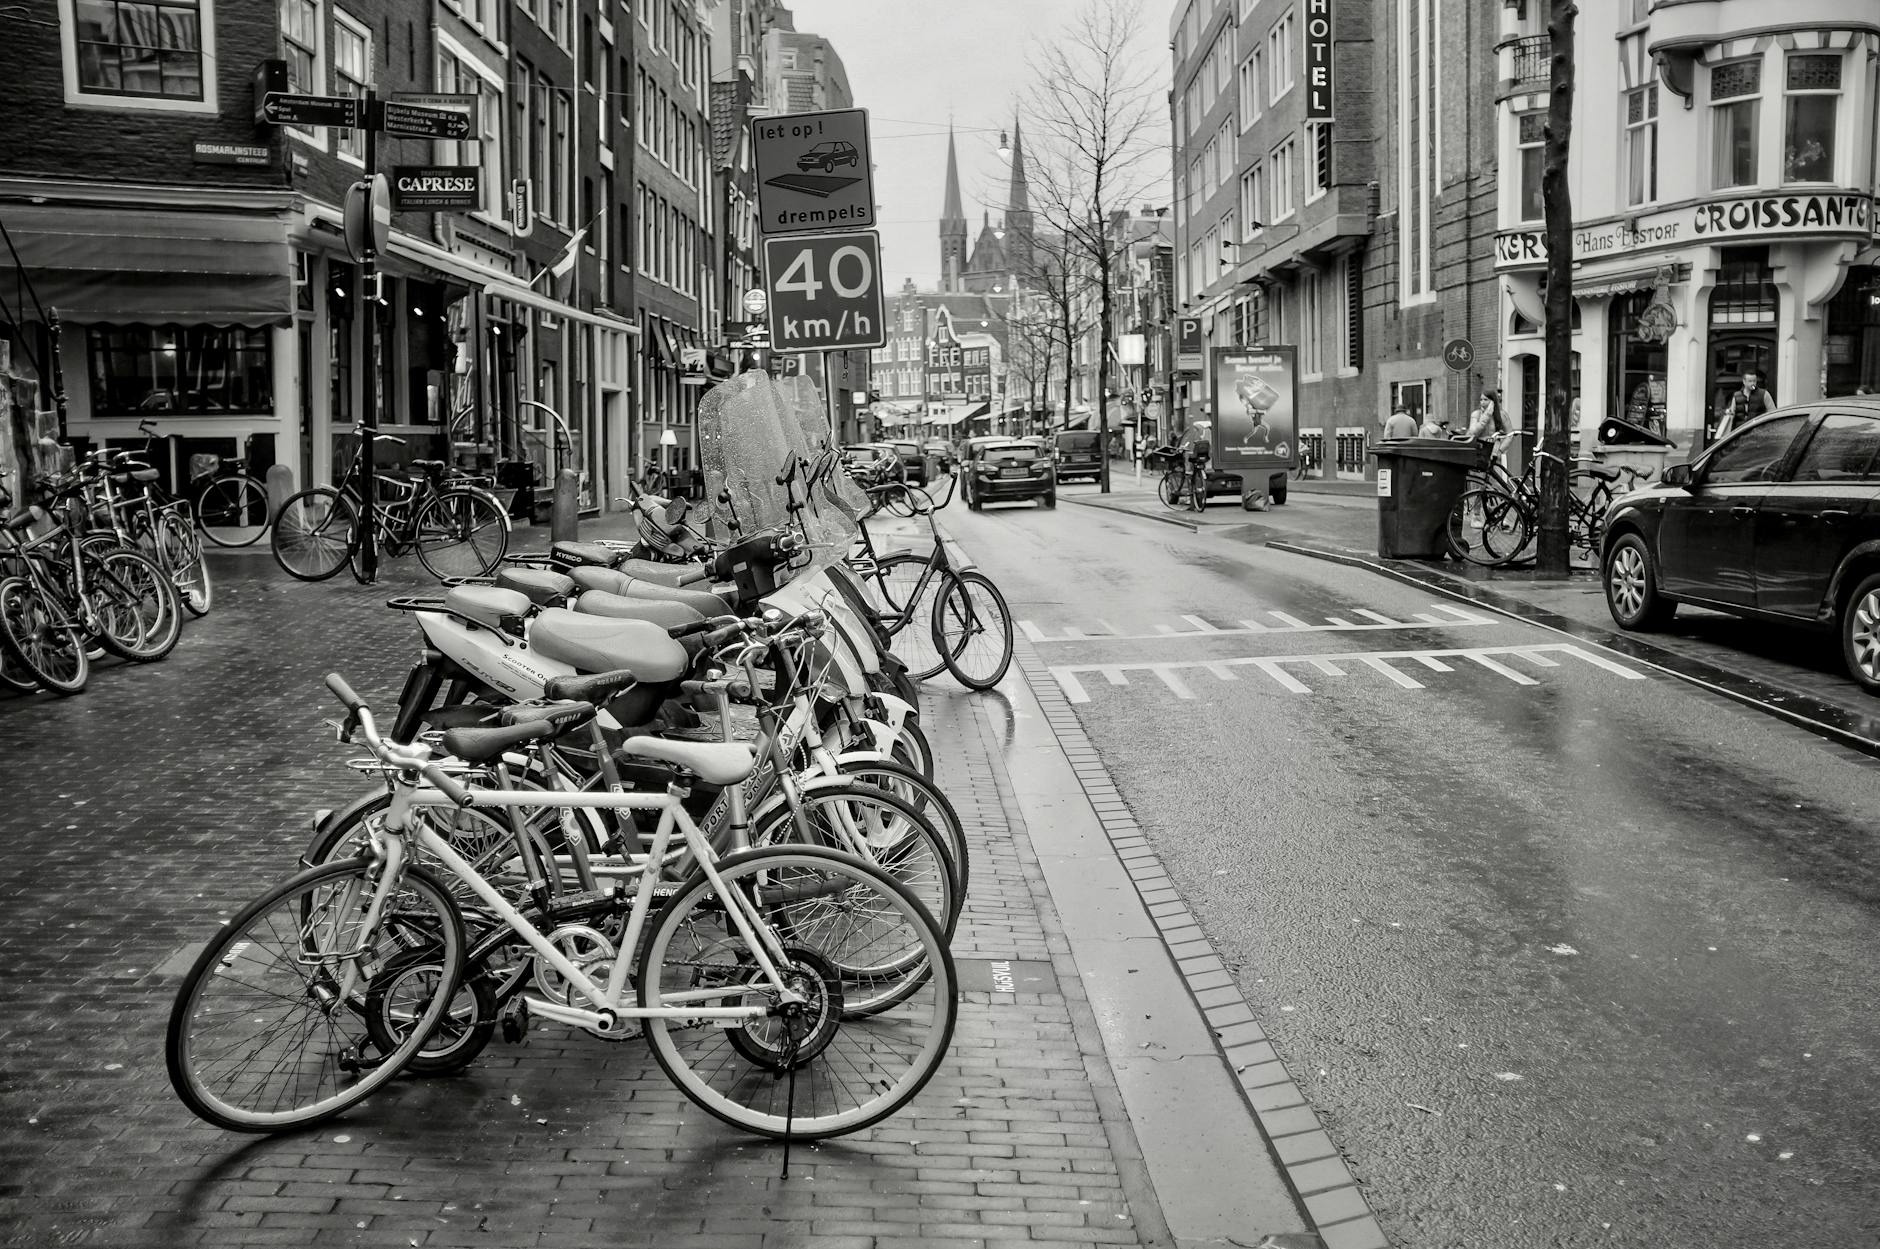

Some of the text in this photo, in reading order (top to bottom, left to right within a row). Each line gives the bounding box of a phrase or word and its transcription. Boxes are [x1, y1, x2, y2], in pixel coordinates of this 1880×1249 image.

[1309, 0, 1328, 110] HOTEL
[387, 114, 424, 124] Westerkerk
[411, 110, 438, 119] Museum
[387, 122, 429, 133] Marnixstraat
[760, 124, 785, 140] let
[195, 144, 268, 157] ROSMARIJNSTEEG
[398, 177, 475, 191] CAPRESE
[778, 204, 866, 224] drempels
[1576, 232, 1613, 252] Hans
[775, 245, 872, 301] 40
[783, 310, 871, 340] km/h
[1183, 321, 1197, 339] P
[786, 359, 796, 373] P
[555, 551, 583, 563] KYMCO
